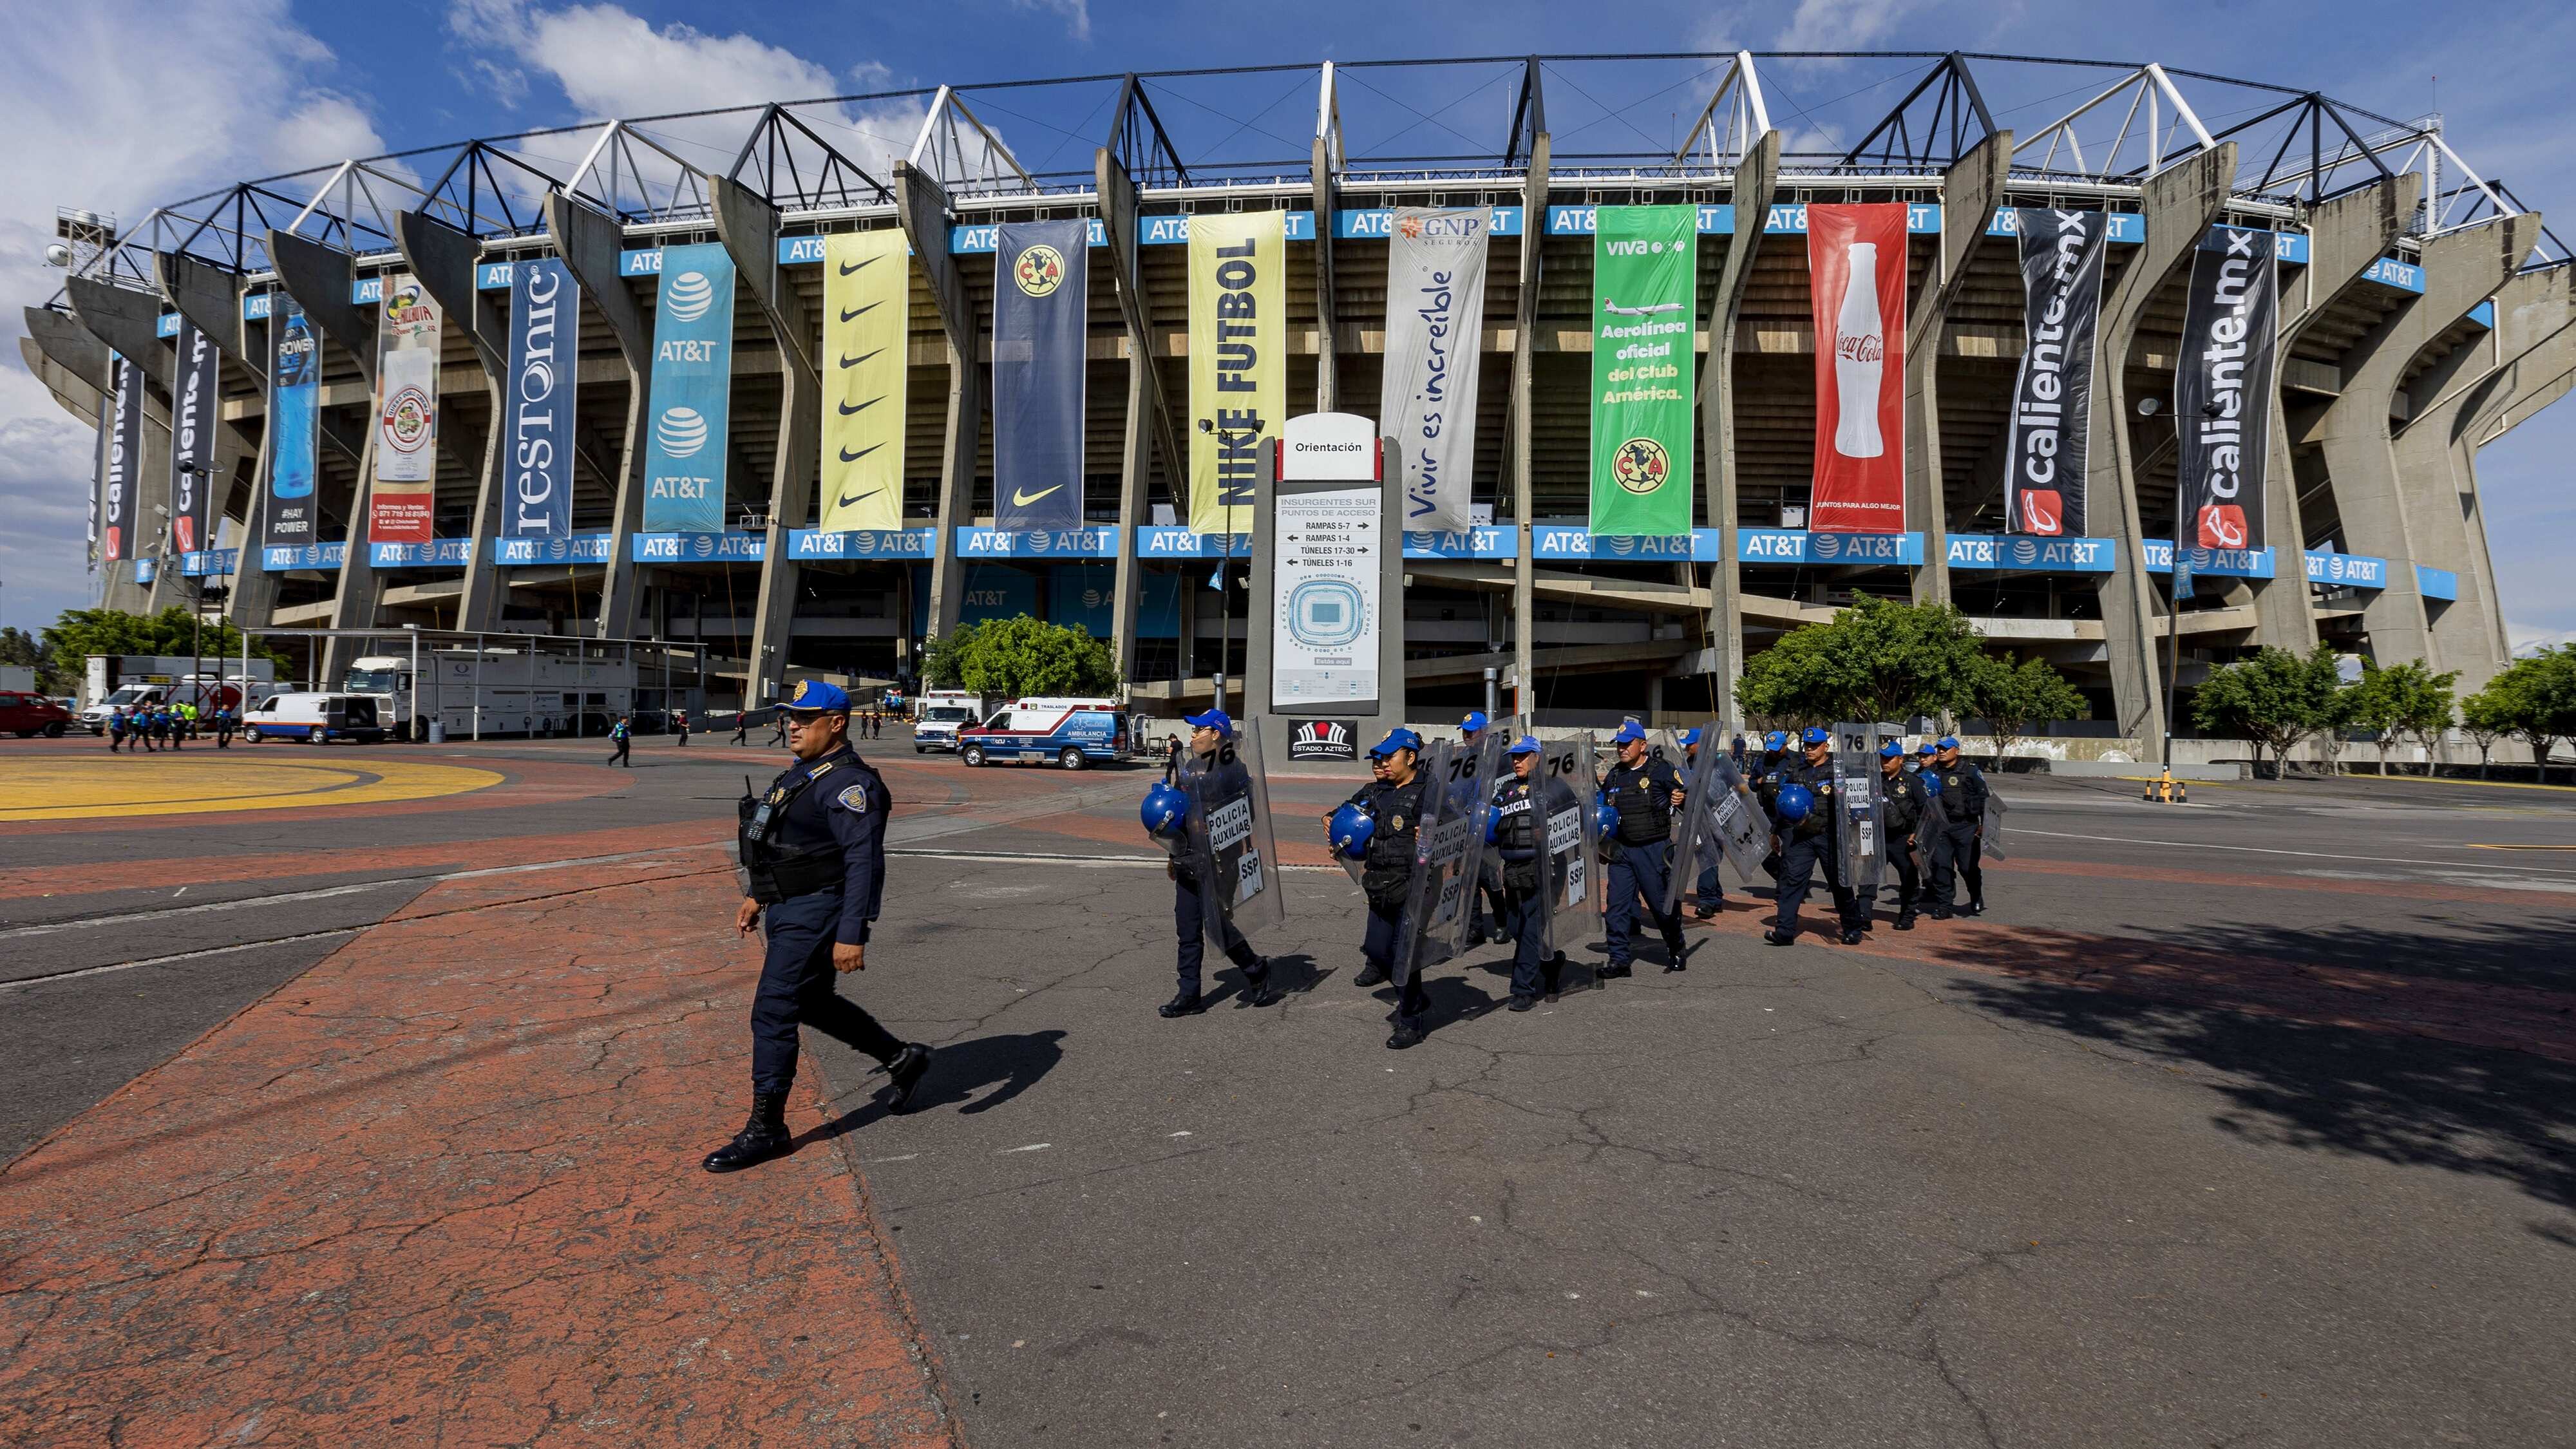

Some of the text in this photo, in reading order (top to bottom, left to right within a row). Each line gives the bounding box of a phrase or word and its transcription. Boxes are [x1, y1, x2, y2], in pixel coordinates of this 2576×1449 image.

[1425, 218, 1479, 236] GNP
[1987, 211, 2016, 232] T&
[1423, 238, 1480, 247] SEGUROS
[2382, 261, 2415, 287] AT&T
[1601, 321, 1686, 338] Aerolínea
[279, 338, 315, 356] POWER
[658, 340, 716, 362] AT&T
[1616, 342, 1670, 360] oficial
[2018, 209, 2086, 484] caliente.mx
[1215, 237, 1257, 506] NIKE FUTBOL
[1607, 364, 1678, 382] del Club
[2200, 229, 2253, 499] caliente.mx
[1409, 270, 1452, 517] Vivir es increíble
[1603, 386, 1683, 404] América.
[1296, 442, 1362, 452] Orientación
[651, 477, 710, 498] AT&T
[281, 508, 303, 519] #HAY
[274, 522, 309, 534] POWER
[505, 541, 545, 559] AT&T
[570, 539, 612, 557] AT&T
[643, 538, 689, 556] AT&T
[717, 536, 765, 555] AT&T
[800, 533, 849, 553] AT&T
[880, 532, 934, 552] AT&T
[968, 533, 1023, 551] AT&T
[1056, 531, 1112, 551] AT&T
[1150, 532, 1202, 551] AT&T
[1301, 545, 1333, 554] TÚNELES
[1441, 531, 1500, 551] AT&T
[1541, 532, 1596, 553] AT&T
[1640, 534, 1701, 554] AT&T
[1746, 535, 1806, 556] AT&T
[1845, 536, 1907, 558] AT&T
[1948, 540, 2005, 561] AT&T
[270, 549, 302, 565] AT&T
[379, 545, 415, 562] AT&T
[439, 543, 472, 560] AT&
[2042, 542, 2100, 564] AT&T
[2214, 549, 2263, 569] AT&T
[1303, 558, 1334, 567] TÚNELES
[2345, 561, 2379, 580] AT&T
[965, 591, 1007, 606] AT&T
[1844, 734, 1864, 750] 76
[1200, 742, 1236, 772] 76
[1548, 752, 1575, 778] 76
[1449, 754, 1478, 782] 76
[1845, 782, 1868, 792] POLICIA
[1716, 795, 1735, 816] POLICIA
[1719, 799, 1739, 824] AUXILIAR
[1209, 804, 1248, 832] POLICIA
[1548, 811, 1579, 835] POLICIA
[1434, 822, 1467, 843] POLICIA
[1861, 827, 1872, 840] SSP
[1241, 857, 1258, 880] SSP
[1569, 865, 1584, 887] SSP
[1442, 882, 1459, 903] SSP
